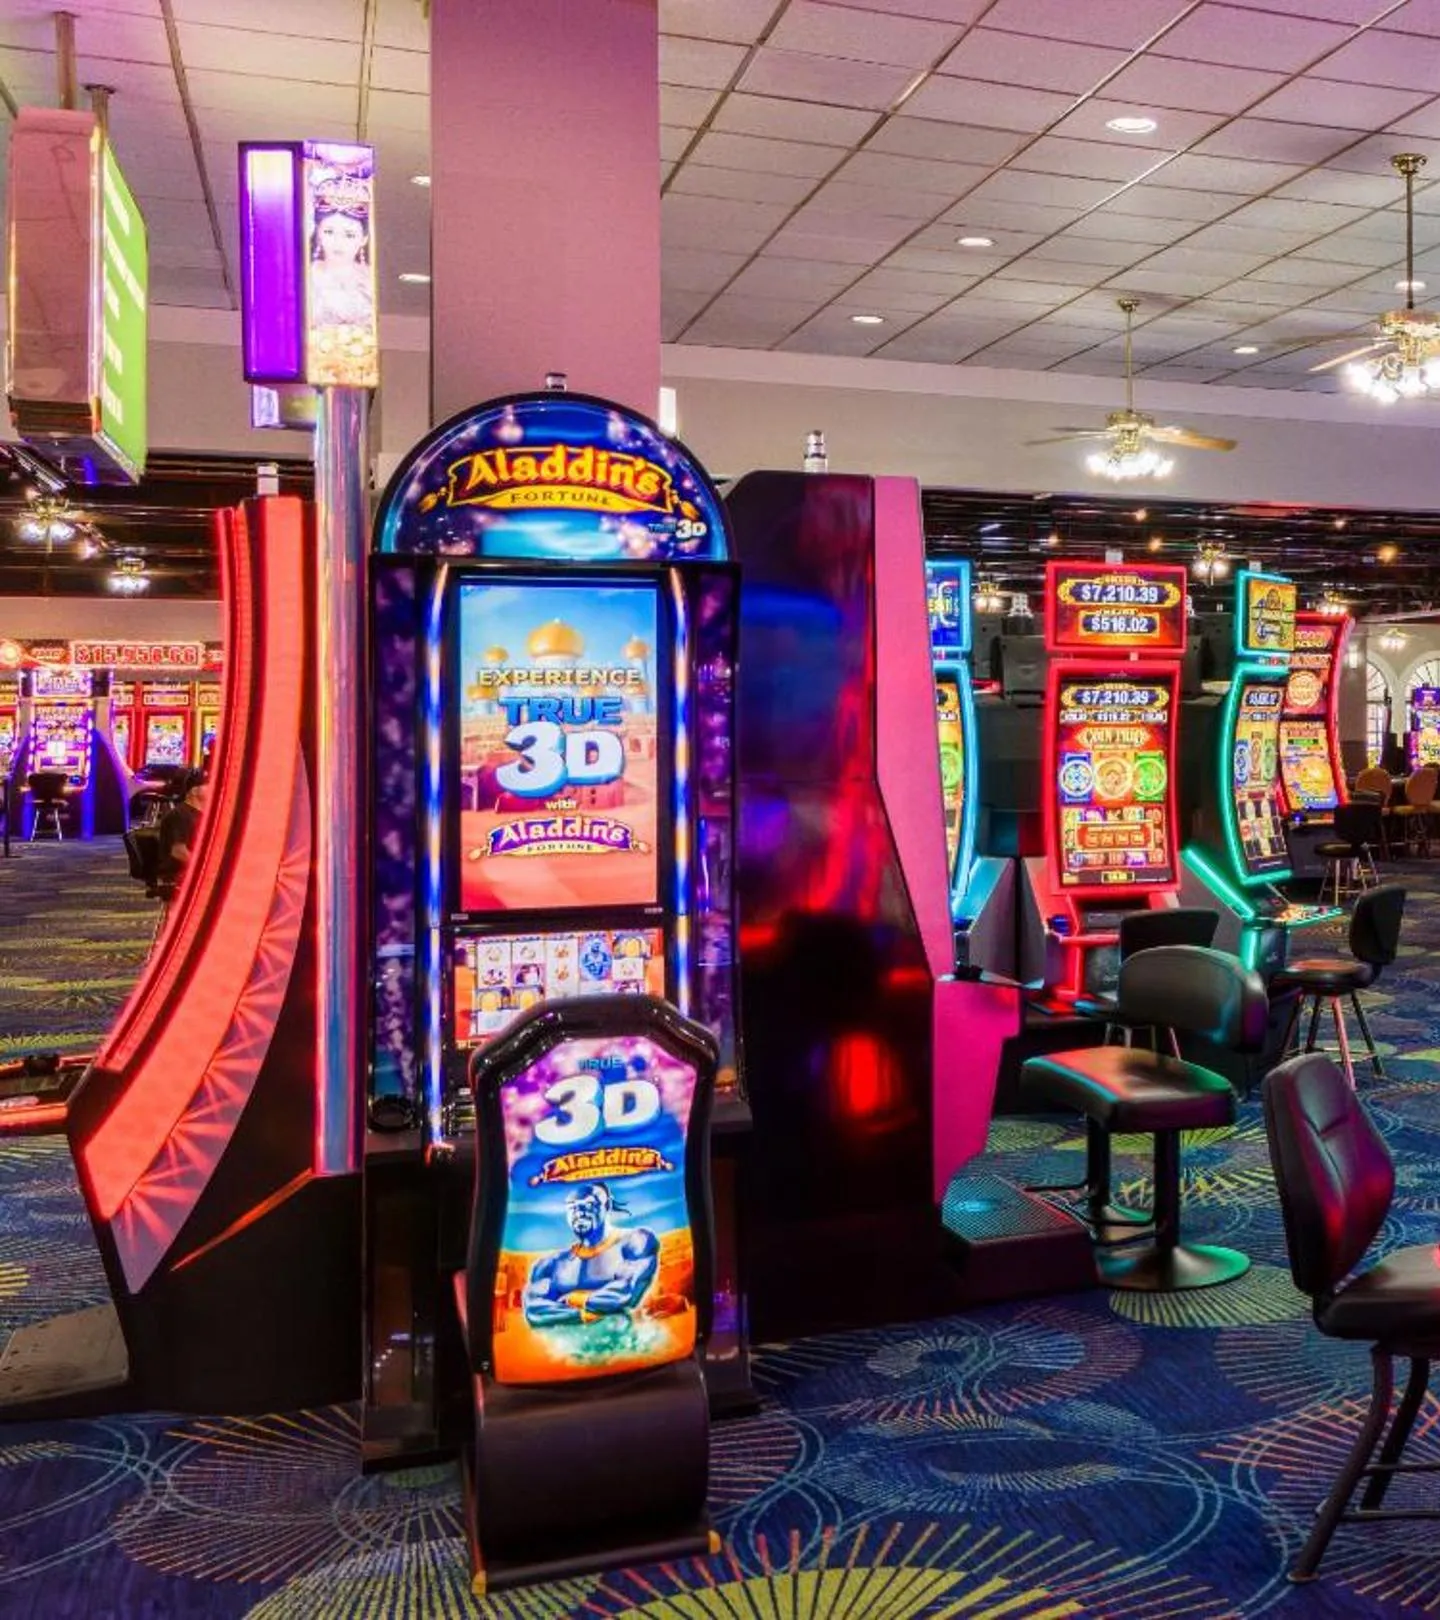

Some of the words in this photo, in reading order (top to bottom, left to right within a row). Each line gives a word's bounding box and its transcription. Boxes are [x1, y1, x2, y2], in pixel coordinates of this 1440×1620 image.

[467, 443, 660, 498] Aladdin's
[509, 490, 611, 506] FORTUNE
[675, 519, 707, 538] 3D
[1081, 584, 1159, 603] $7,210.39
[1091, 617, 1149, 632] $516.02
[479, 669, 641, 686] EXPERIENCE
[499, 696, 624, 726] TRUE
[495, 721, 626, 798] 3D
[500, 815, 627, 843] Aladdin's
[535, 1074, 662, 1145] 3D
[550, 1147, 656, 1176] Aladdin's
